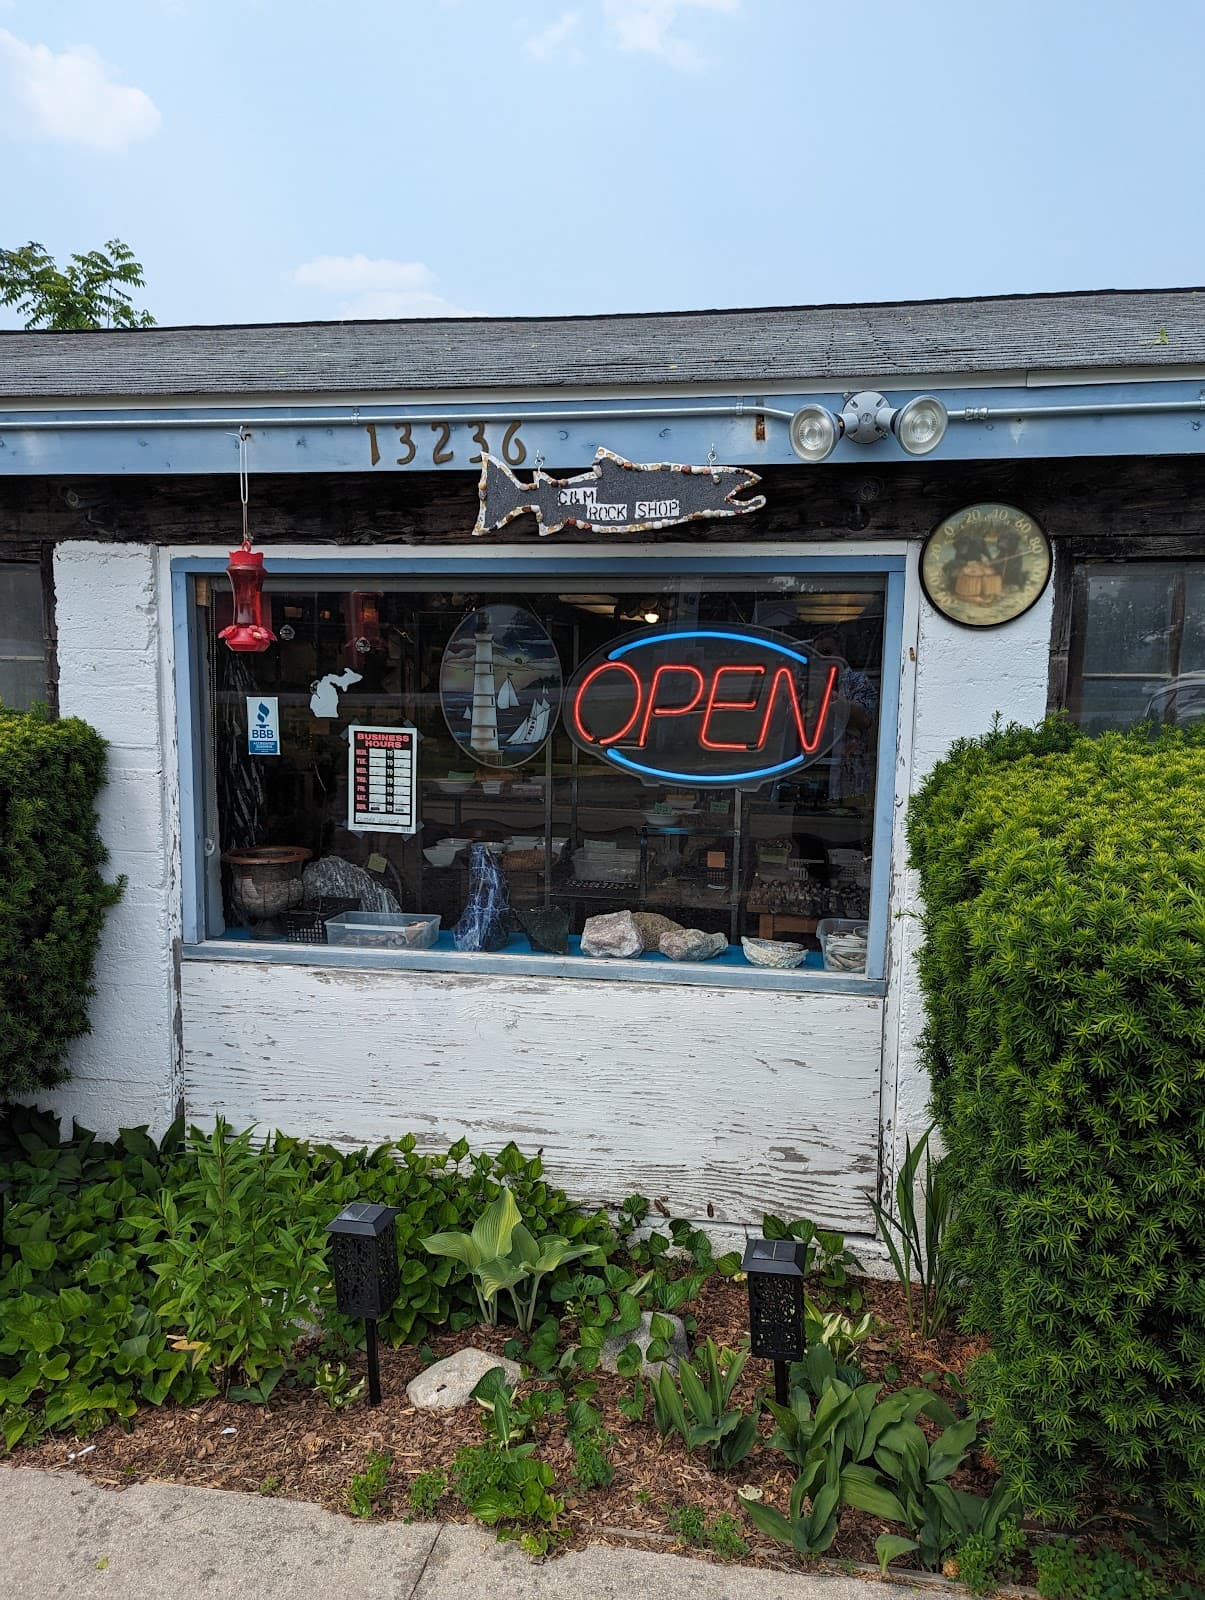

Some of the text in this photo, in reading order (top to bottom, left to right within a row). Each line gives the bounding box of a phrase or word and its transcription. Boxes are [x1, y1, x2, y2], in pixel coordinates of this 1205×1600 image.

[366, 420, 527, 466] 13236
[588, 501, 678, 520] ROCK SHOP
[574, 661, 838, 753] OPEN
[252, 729, 274, 739] BBB
[356, 733, 410, 743] BUSINESS
[365, 740, 402, 748] HOURS
